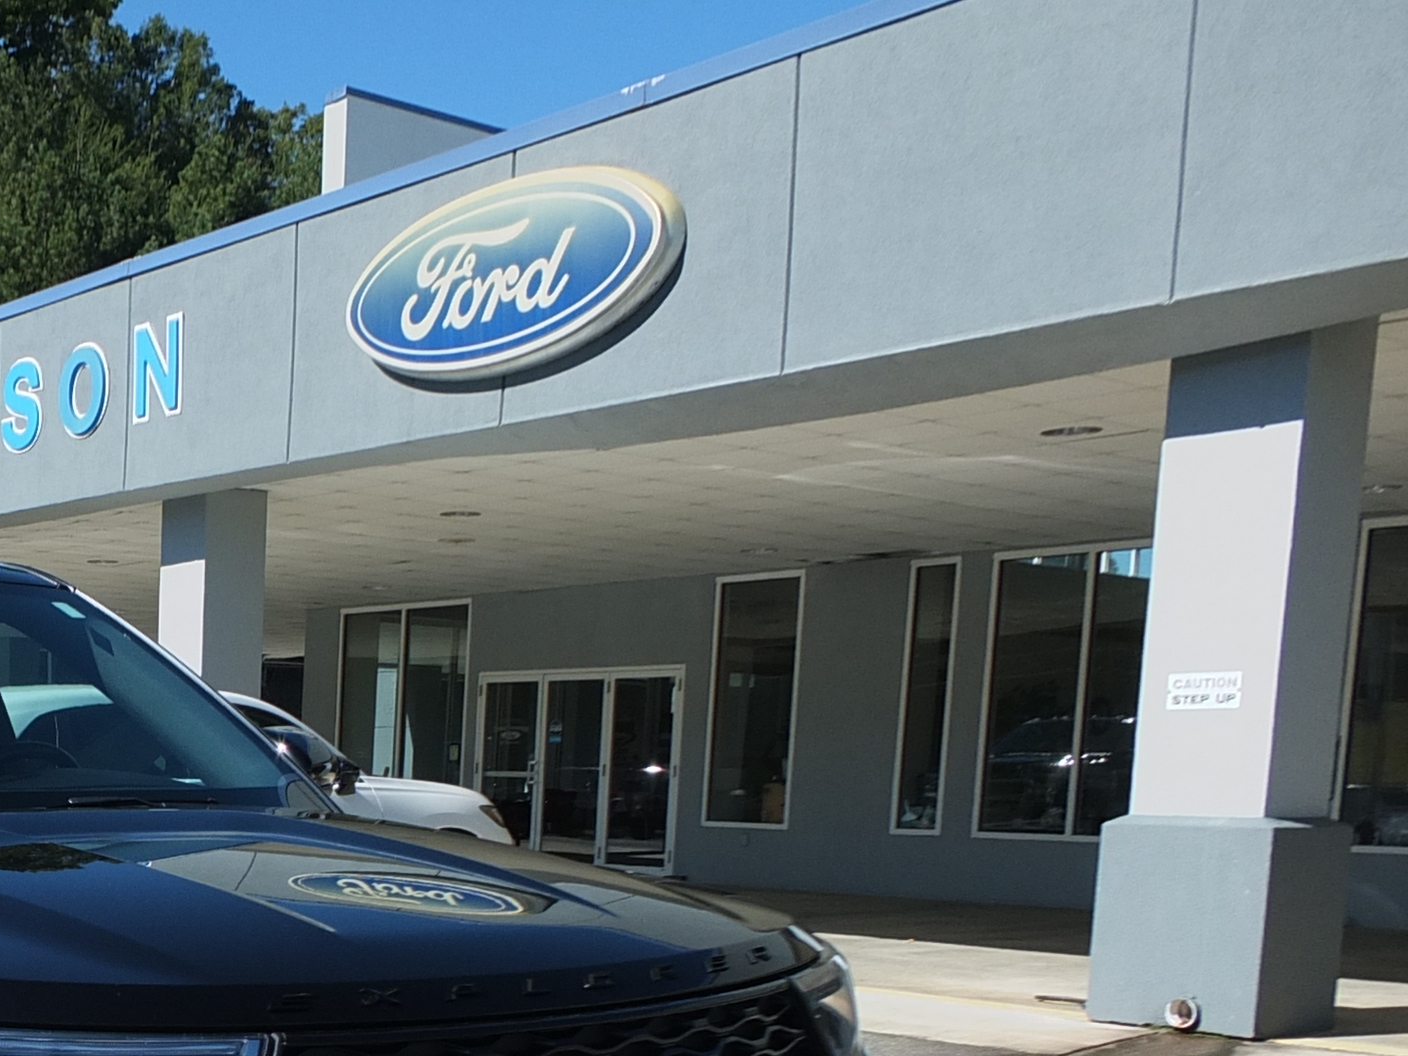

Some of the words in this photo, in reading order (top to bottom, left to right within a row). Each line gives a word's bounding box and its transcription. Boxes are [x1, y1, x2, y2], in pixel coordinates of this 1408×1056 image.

[400, 217, 576, 342] Ford
[1172, 676, 1239, 690] CAUTION
[1171, 692, 1211, 706] STEP
[1215, 692, 1238, 704] UP
